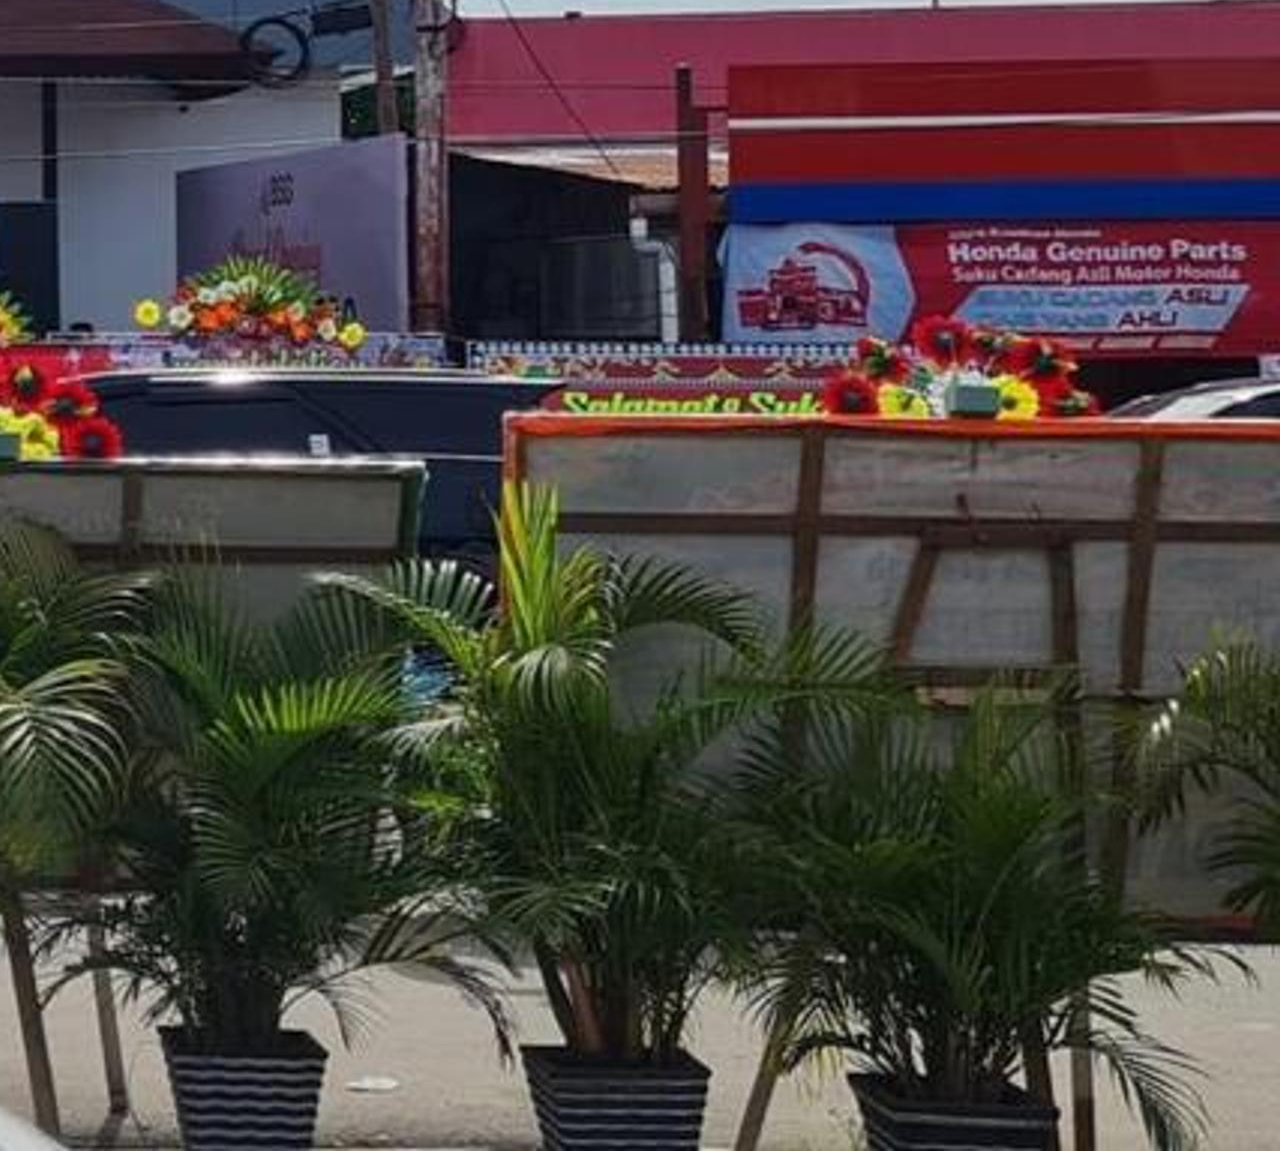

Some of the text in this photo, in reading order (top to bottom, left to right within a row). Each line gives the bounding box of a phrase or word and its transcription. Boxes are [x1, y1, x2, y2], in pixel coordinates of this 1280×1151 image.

[947, 237, 1246, 263] Honda Genuine Parts
[1115, 265, 1171, 281] Motor
[1176, 264, 1239, 280] Honda
[1117, 311, 1179, 328] AHLI
[749, 391, 822, 414] Suk
